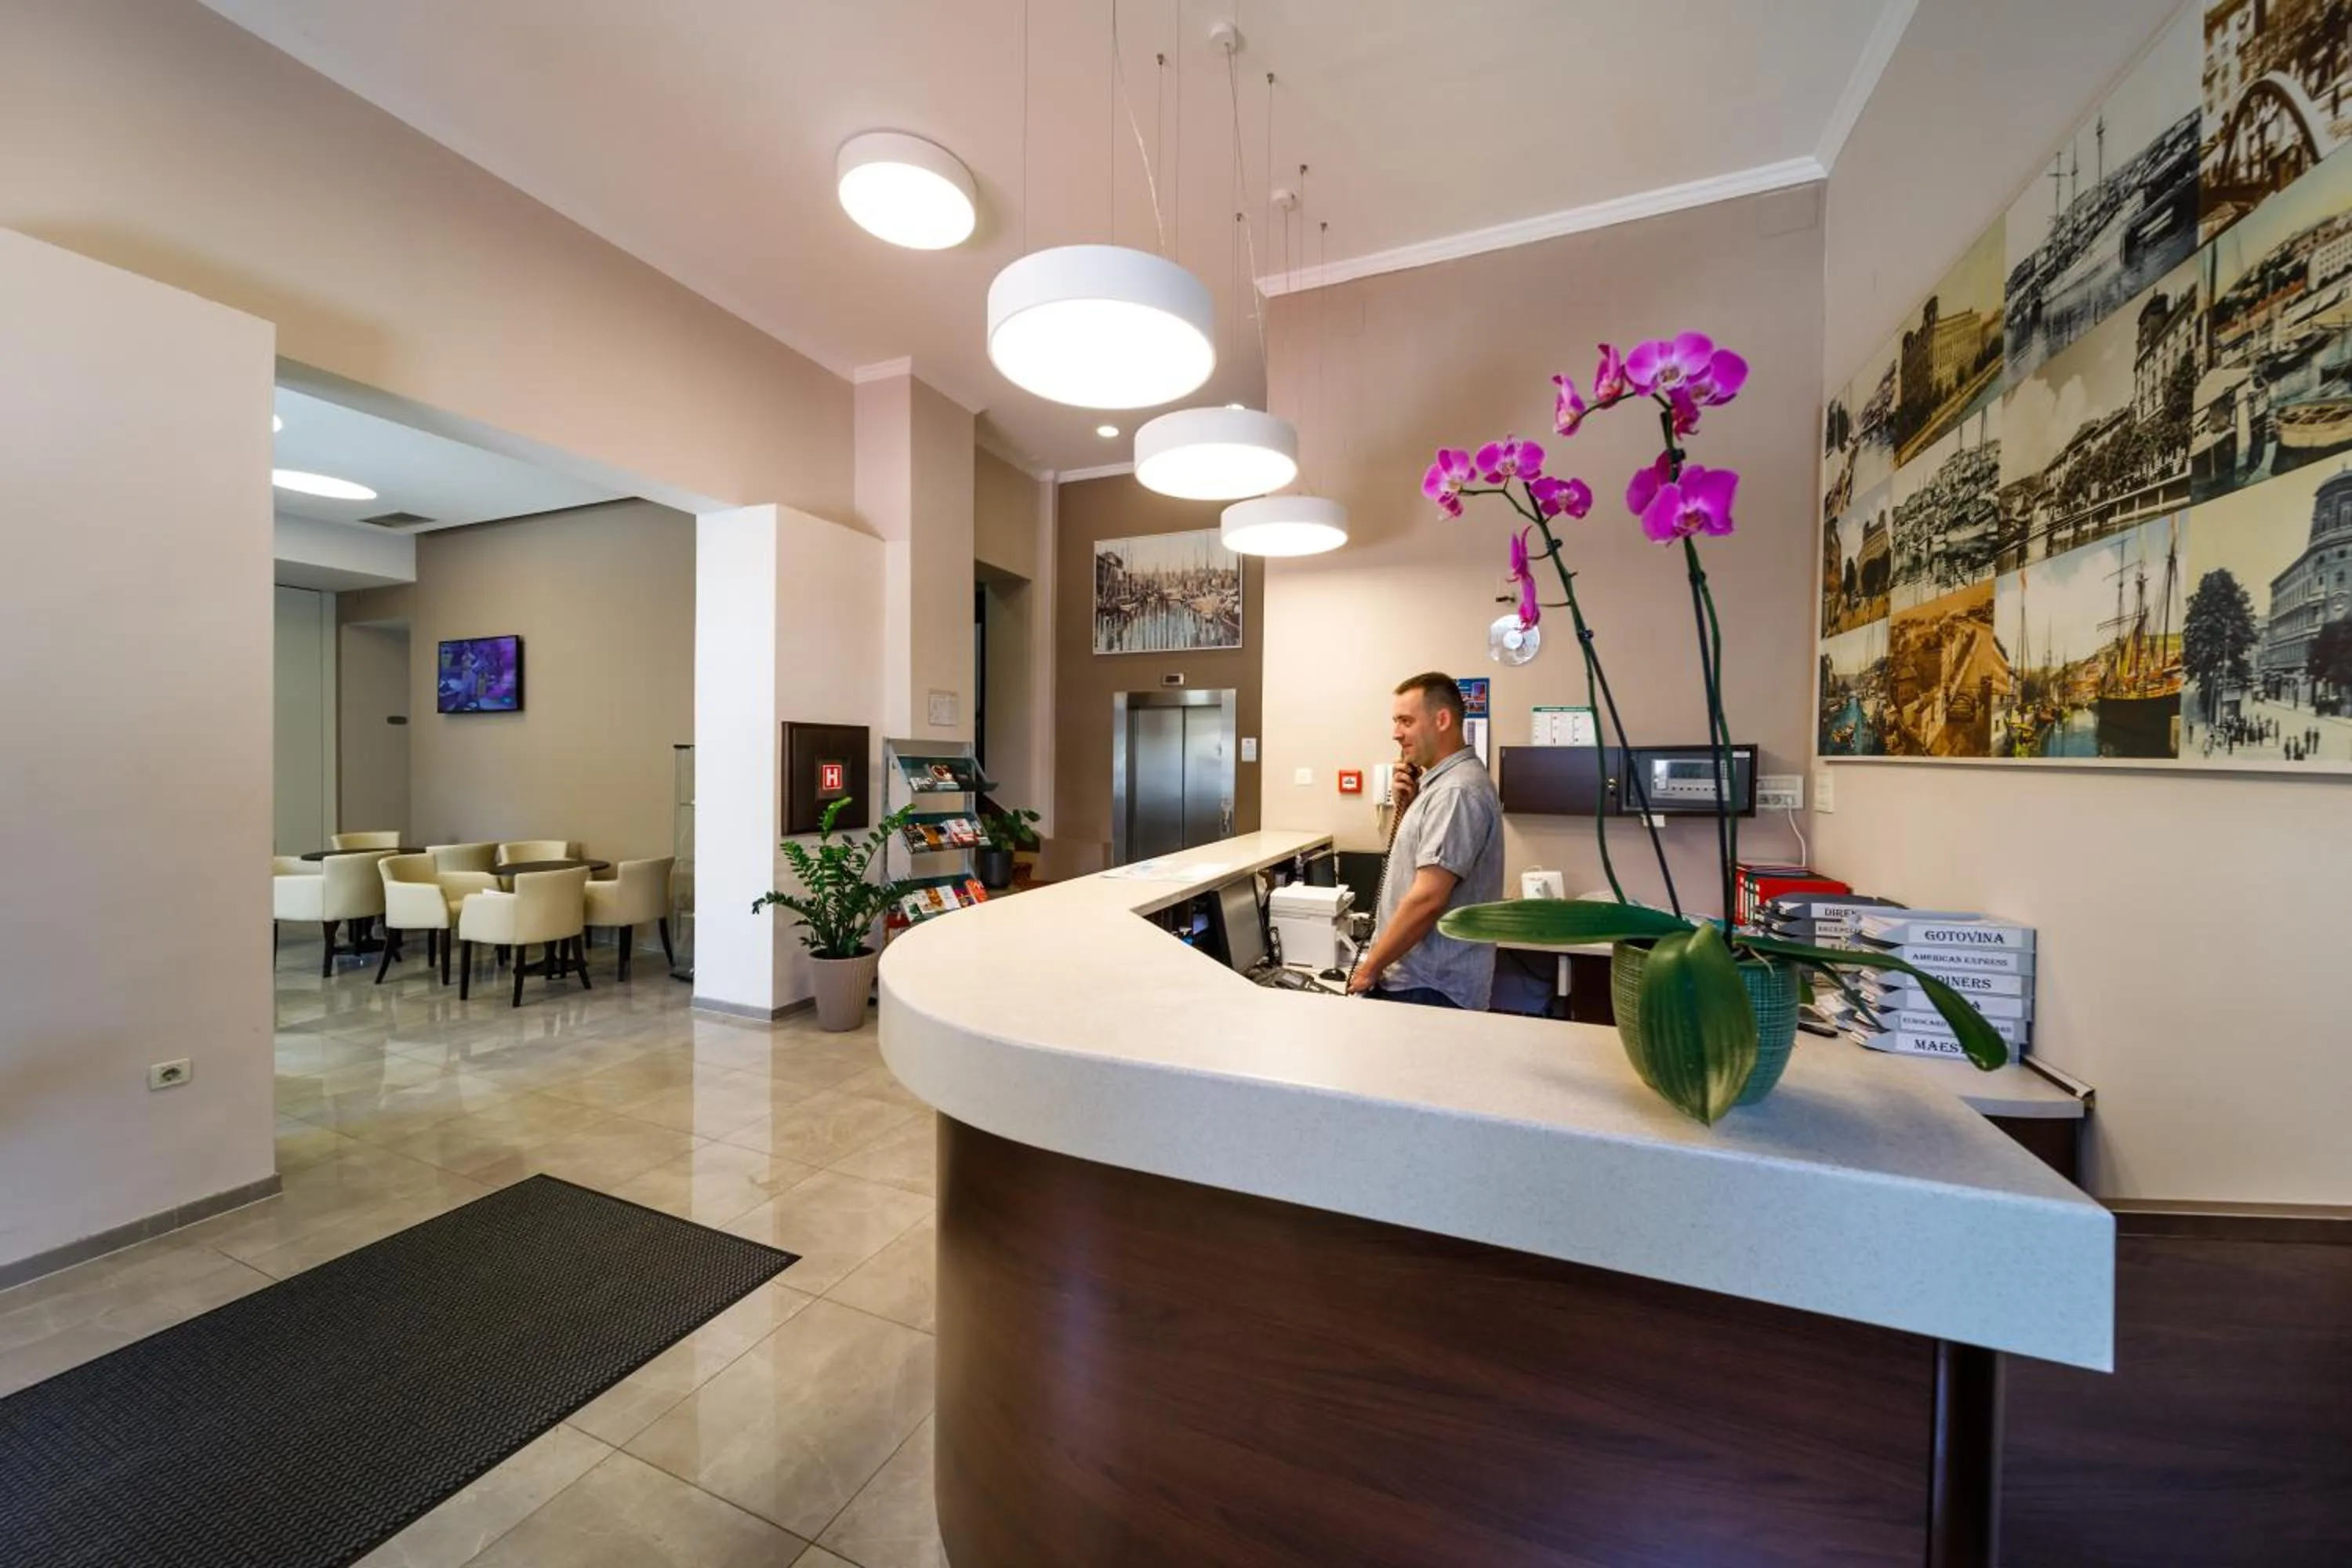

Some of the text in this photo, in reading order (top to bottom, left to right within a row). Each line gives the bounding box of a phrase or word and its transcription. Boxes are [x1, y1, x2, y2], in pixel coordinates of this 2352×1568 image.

[826, 768, 838, 786] H
[1924, 930, 2005, 944] GOTOVINA
[1912, 953, 2008, 966] AMERICAN EXPRESS
[1914, 1038, 1962, 1053] MAES
